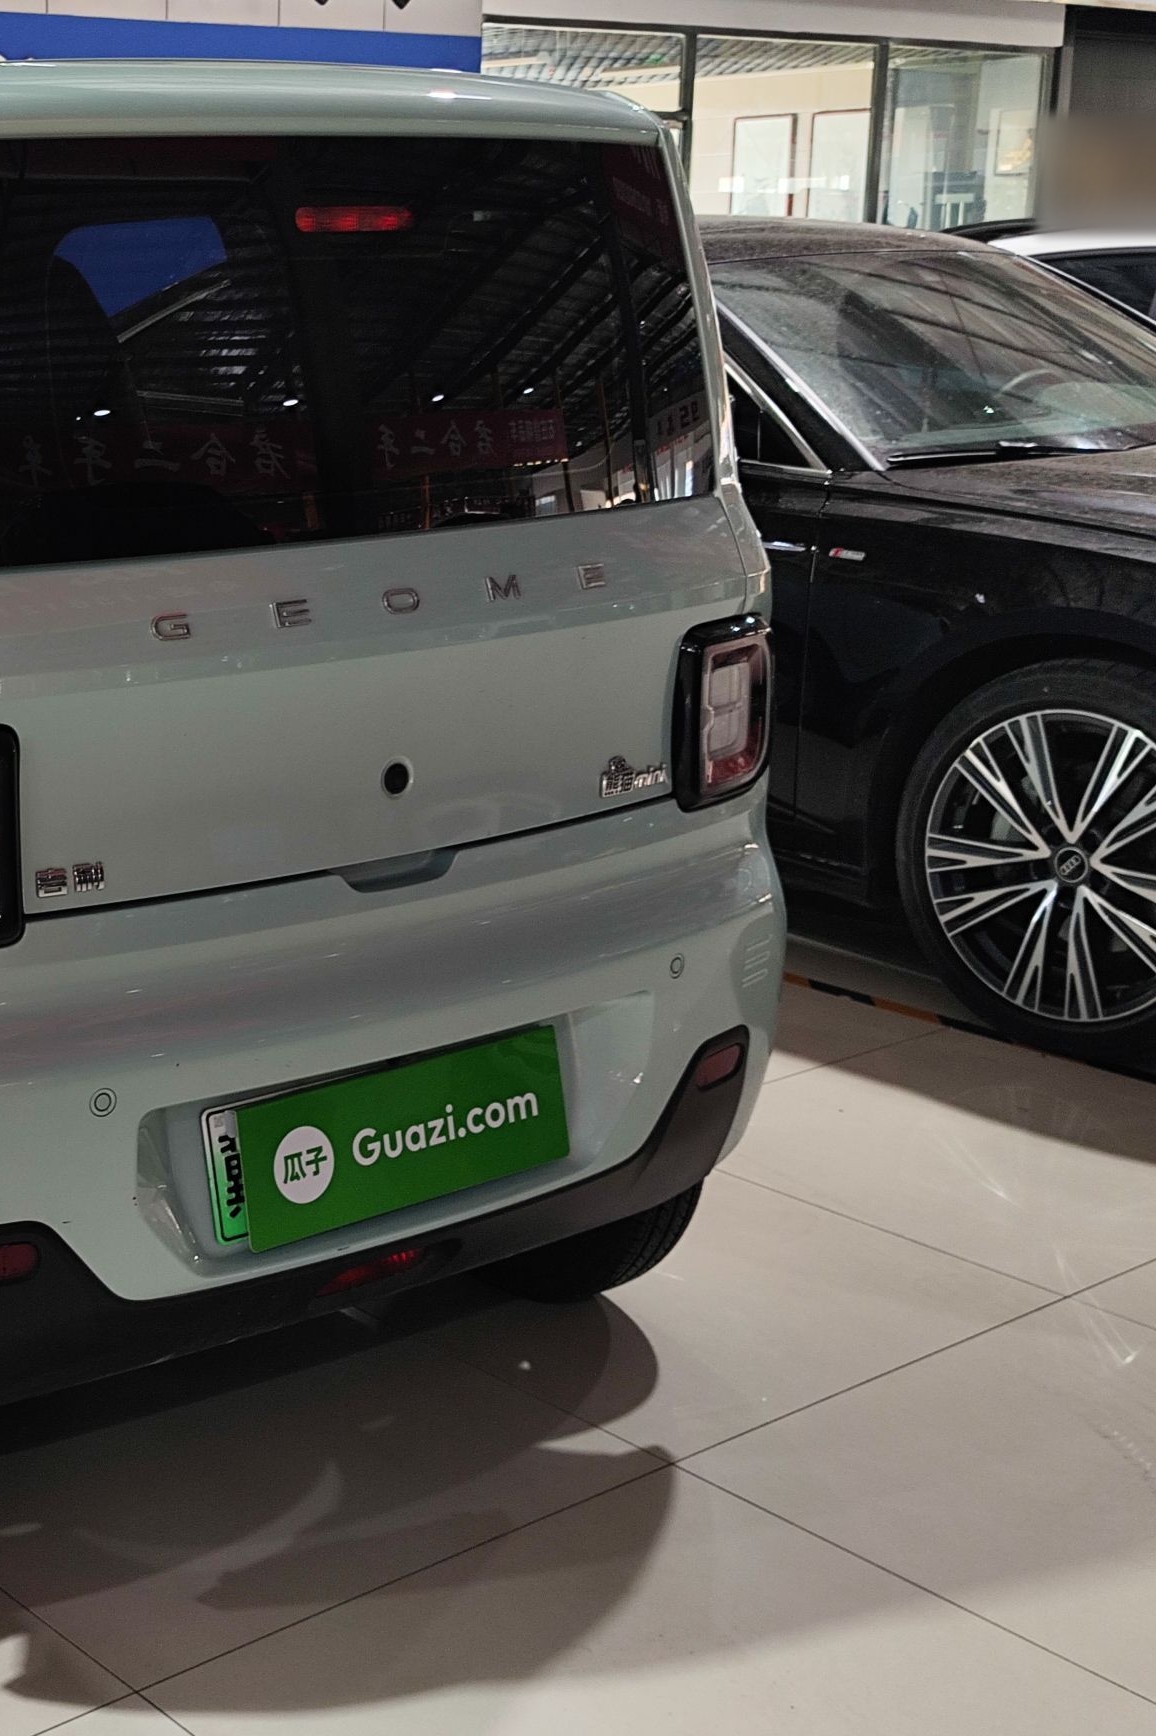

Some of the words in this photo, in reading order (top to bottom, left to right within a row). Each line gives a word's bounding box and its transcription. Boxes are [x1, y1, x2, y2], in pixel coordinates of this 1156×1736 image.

[150, 563, 608, 641] GEOME
[283, 1146, 328, 1184] 瓜子
[352, 1092, 539, 1166] Guazi.com
